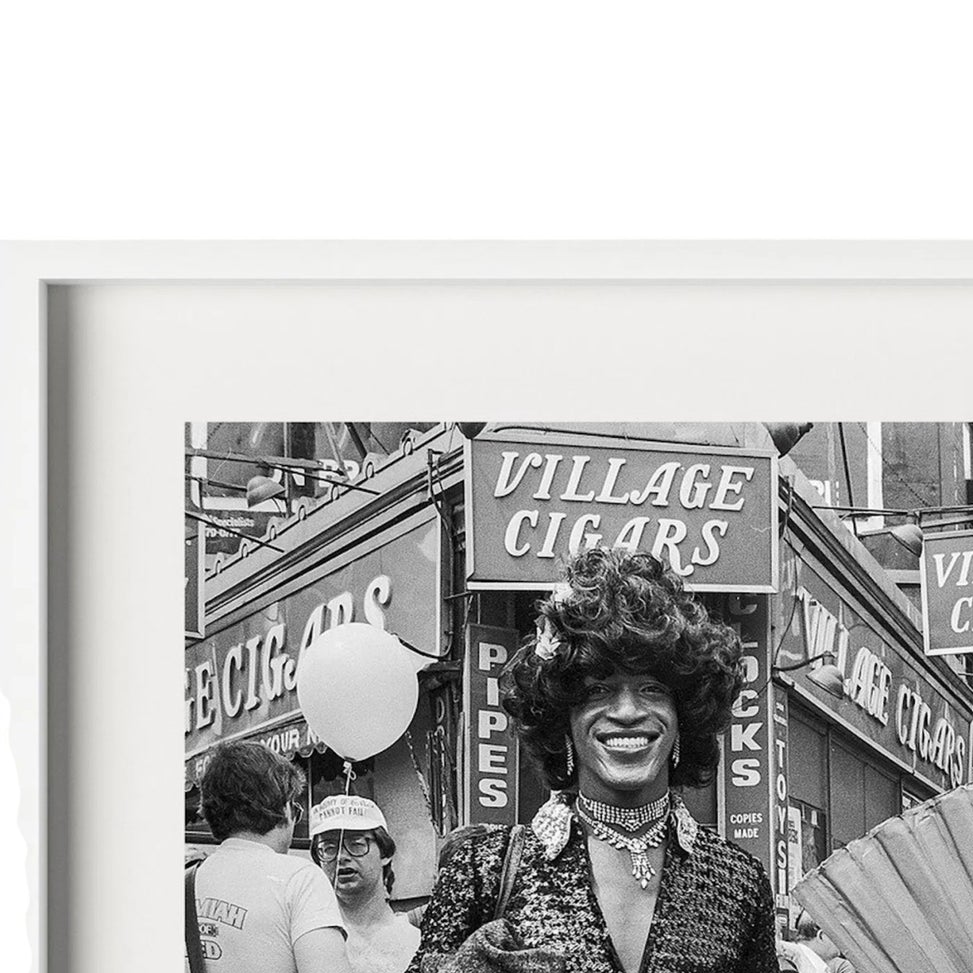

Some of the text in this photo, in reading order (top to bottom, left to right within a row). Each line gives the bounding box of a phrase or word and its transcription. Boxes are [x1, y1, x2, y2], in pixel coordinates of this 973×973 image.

[493, 451, 754, 511] VILLAGE
[504, 510, 728, 576] CIGARS
[478, 642, 508, 807] PIPES
[896, 684, 965, 787] CIGARS
[730, 813, 763, 824] COPIES
[734, 829, 759, 838] MADE
[775, 740, 787, 869] TOYS
